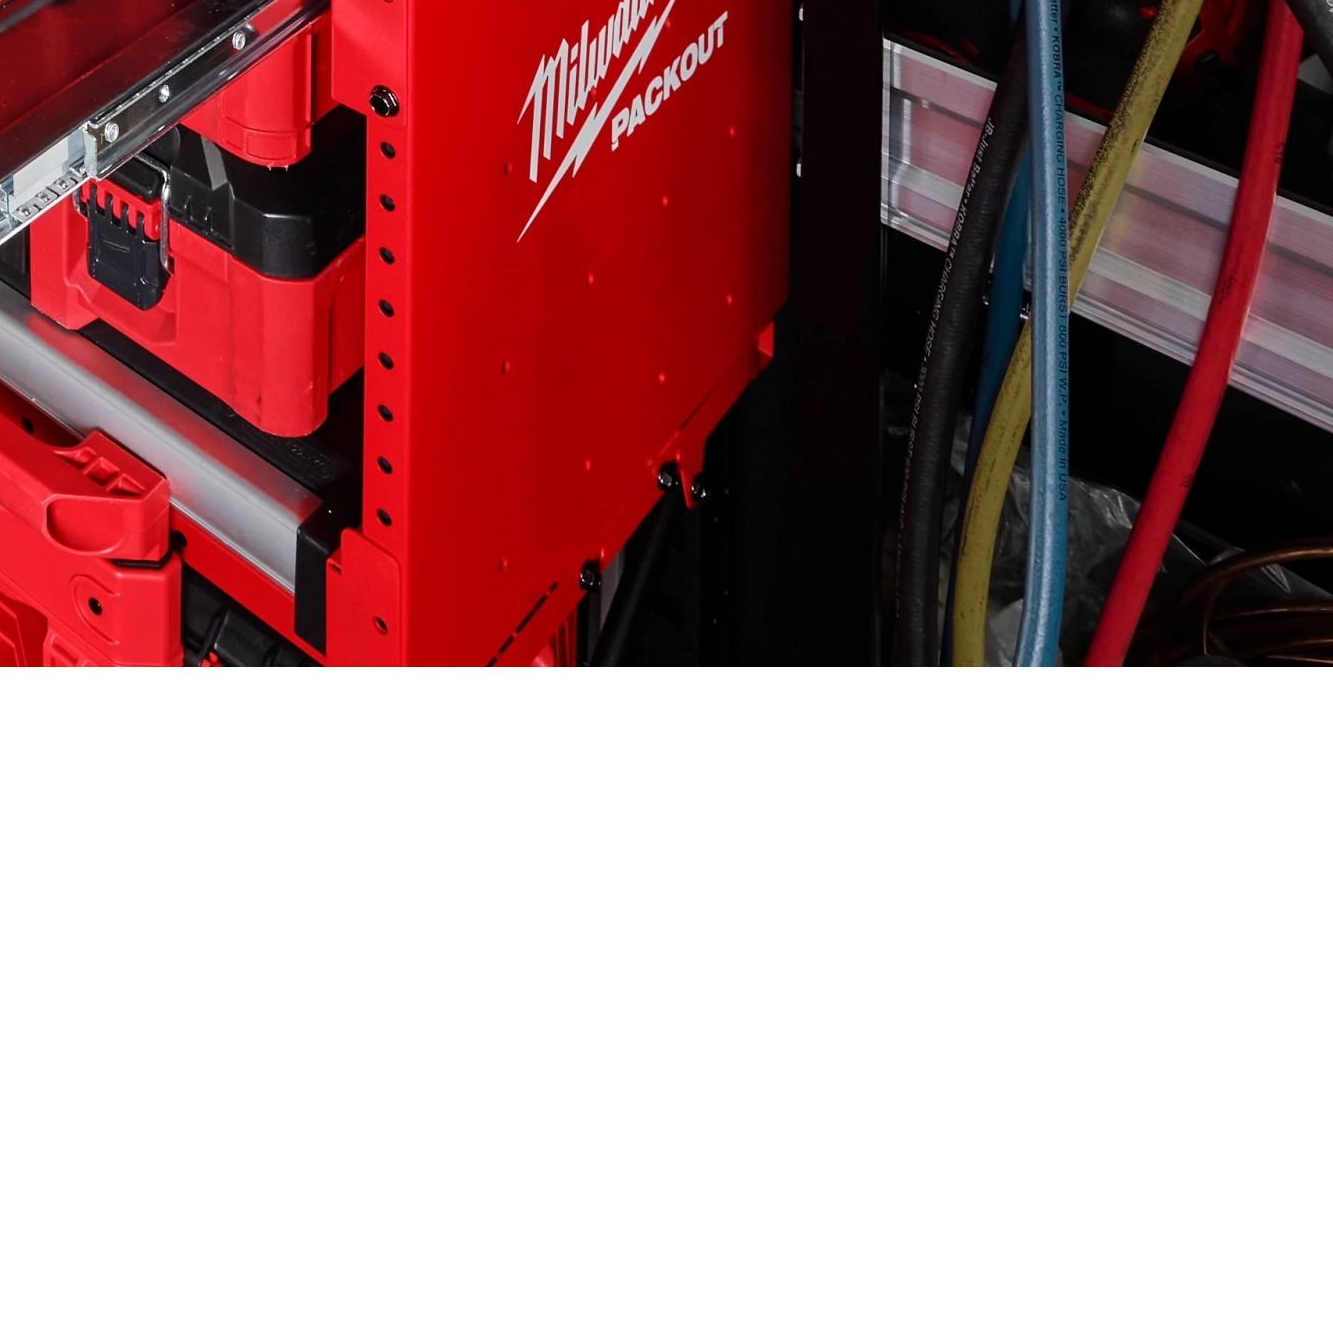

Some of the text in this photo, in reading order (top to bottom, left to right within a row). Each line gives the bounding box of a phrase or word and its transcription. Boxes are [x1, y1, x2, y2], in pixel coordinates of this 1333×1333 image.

[611, 11, 728, 151] PACKOUT
[1054, 94, 1065, 157] CHARGING
[1056, 159, 1066, 204] HOSE
[1058, 217, 1067, 248] 4000
[1059, 251, 1067, 272] PSI
[1059, 275, 1068, 322] BURST
[1059, 325, 1067, 344] 800
[1059, 347, 1067, 371] PSI
[1059, 420, 1067, 448] Made
[1059, 472, 1067, 501] USA
